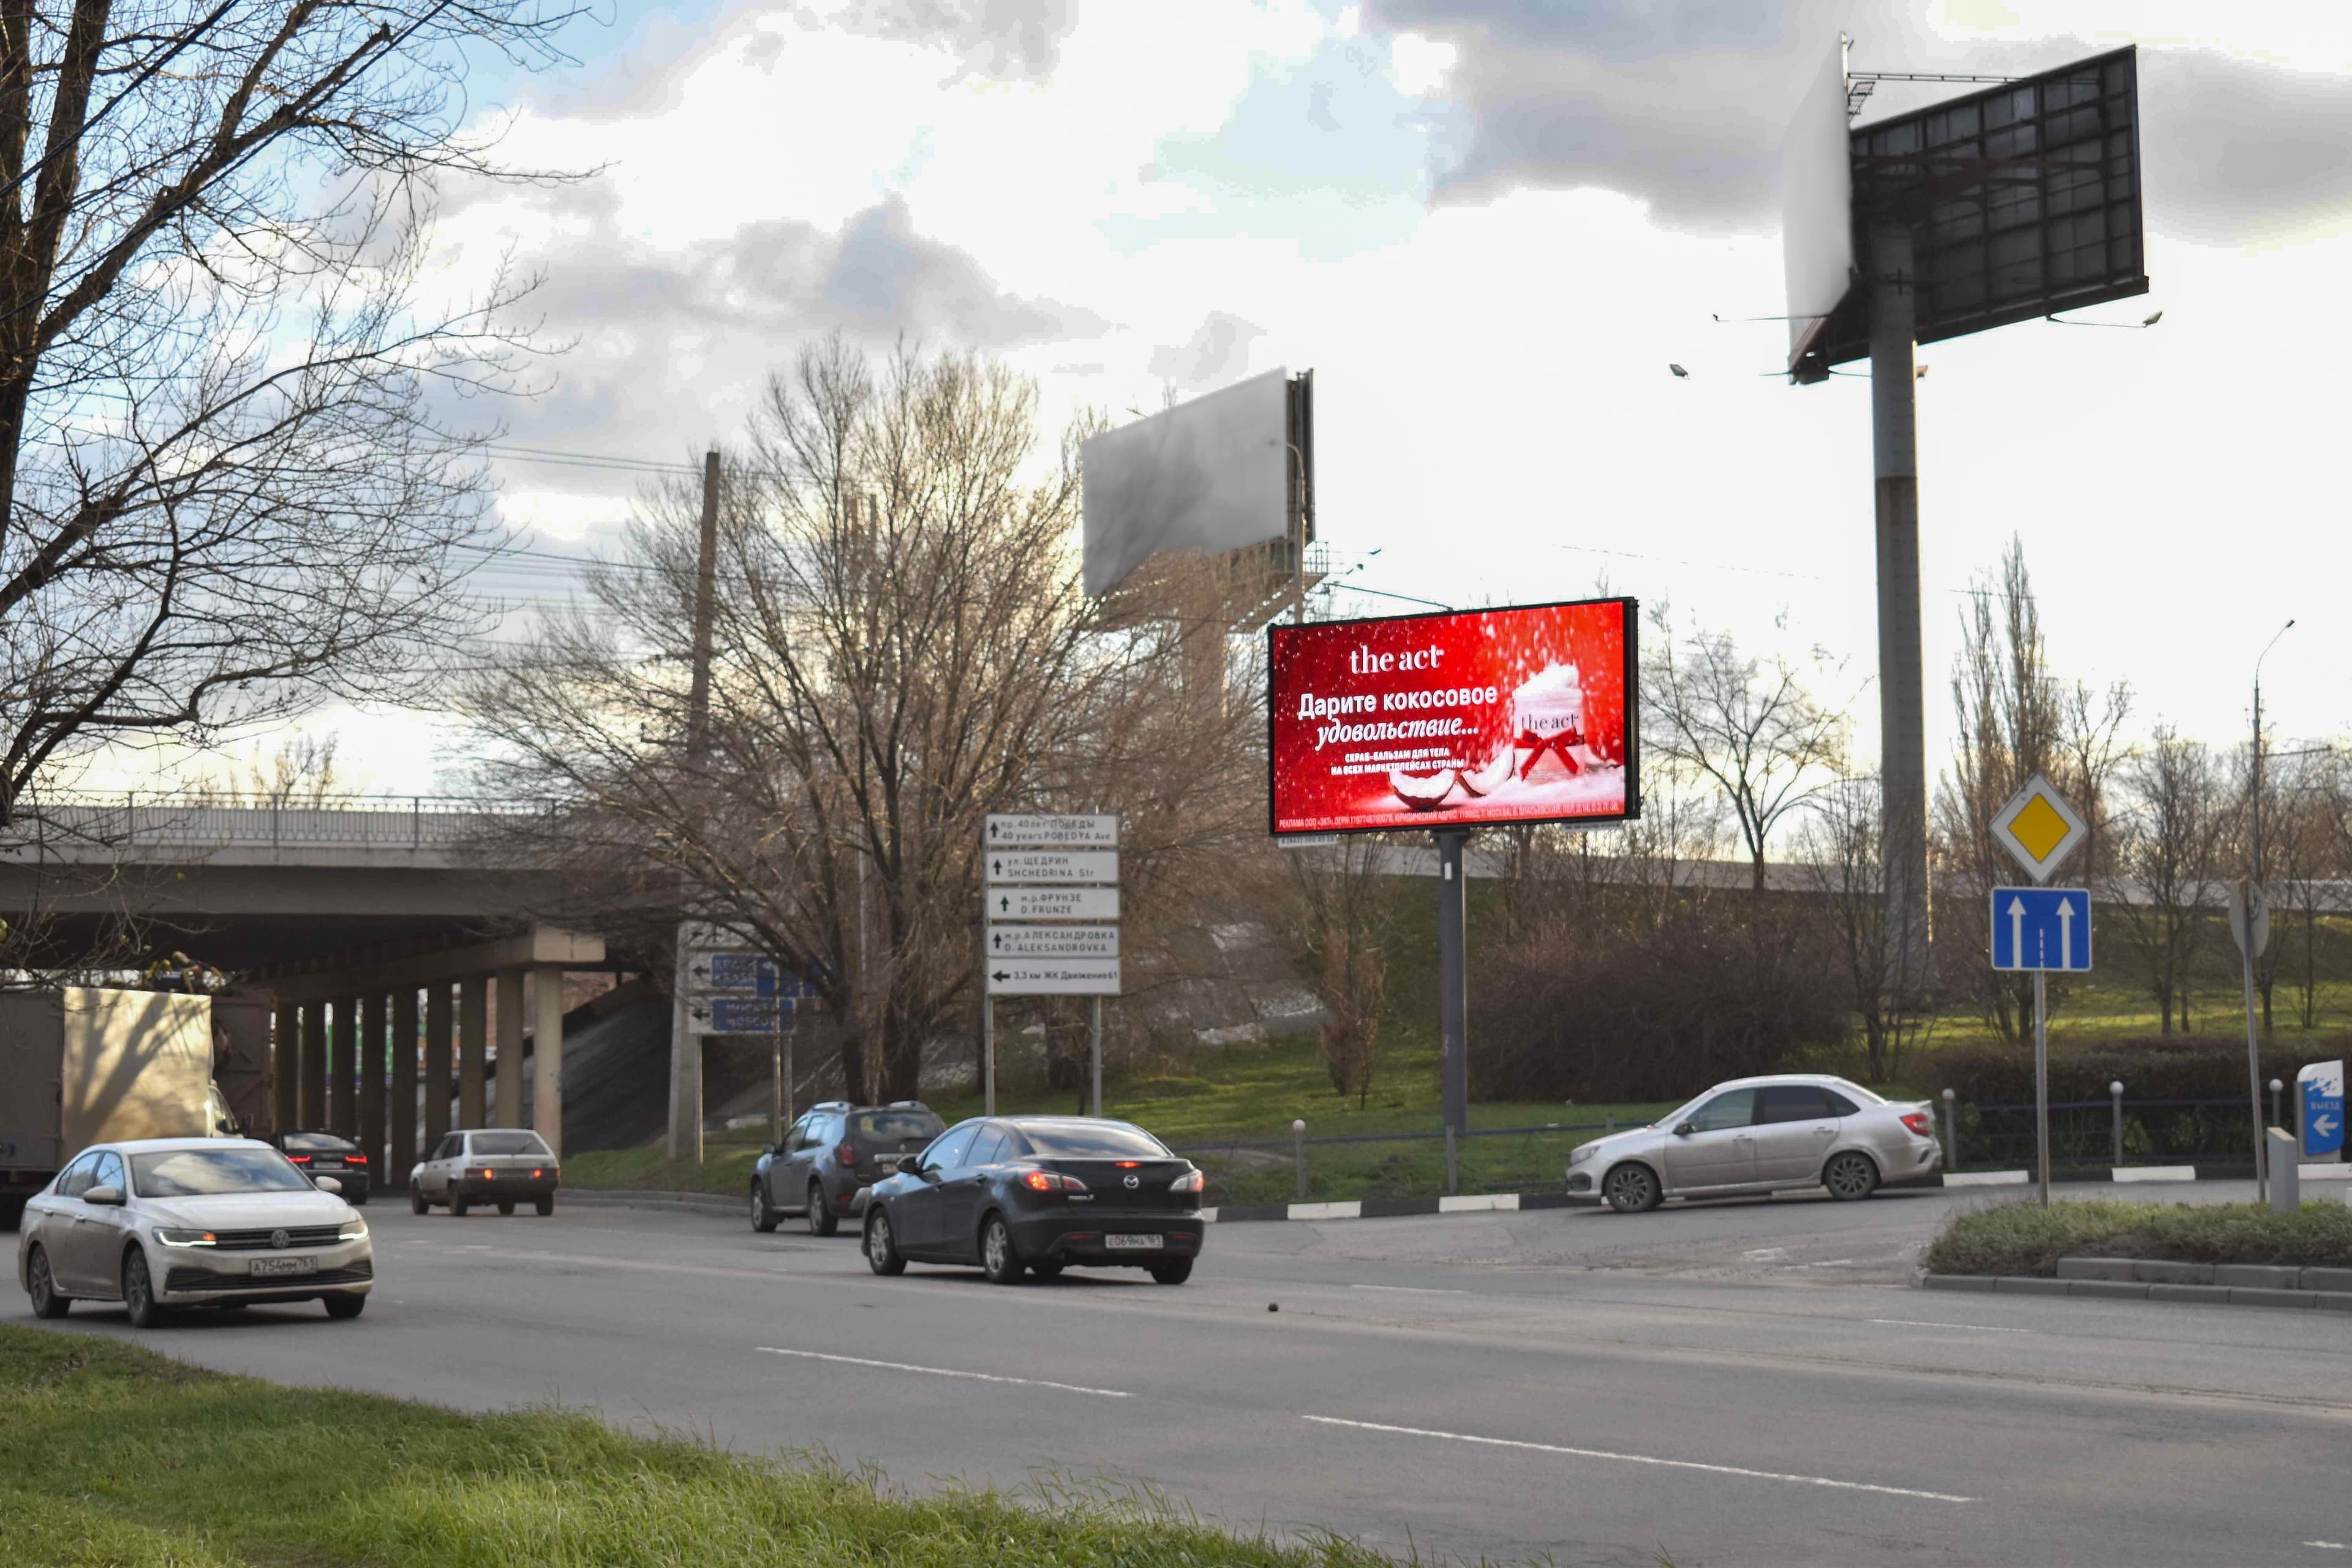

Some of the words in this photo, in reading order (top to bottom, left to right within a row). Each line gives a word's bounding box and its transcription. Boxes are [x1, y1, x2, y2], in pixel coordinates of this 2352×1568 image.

[1350, 644, 1395, 674] the
[1398, 644, 1445, 671] act
[1297, 693, 1377, 720] Дарите
[1383, 686, 1498, 711] кокосовое
[1315, 717, 1479, 752] удовольствие...
[1411, 748, 1429, 760] ДЛЯ
[1430, 747, 1451, 758] ТЕЛА
[1330, 765, 1343, 776] НА
[1343, 764, 1363, 775] ВСЕХ
[1431, 758, 1464, 769] СТРАНЫ
[1001, 832, 1014, 840] 40
[1016, 833, 1042, 842] years
[1044, 831, 1090, 840] POBEDYA
[1007, 868, 1074, 877] SHCHEDRINA
[1079, 868, 1095, 877] Str
[1017, 942, 1107, 952] ALEKSANDROVKA
[1044, 971, 1059, 979] ЖК
